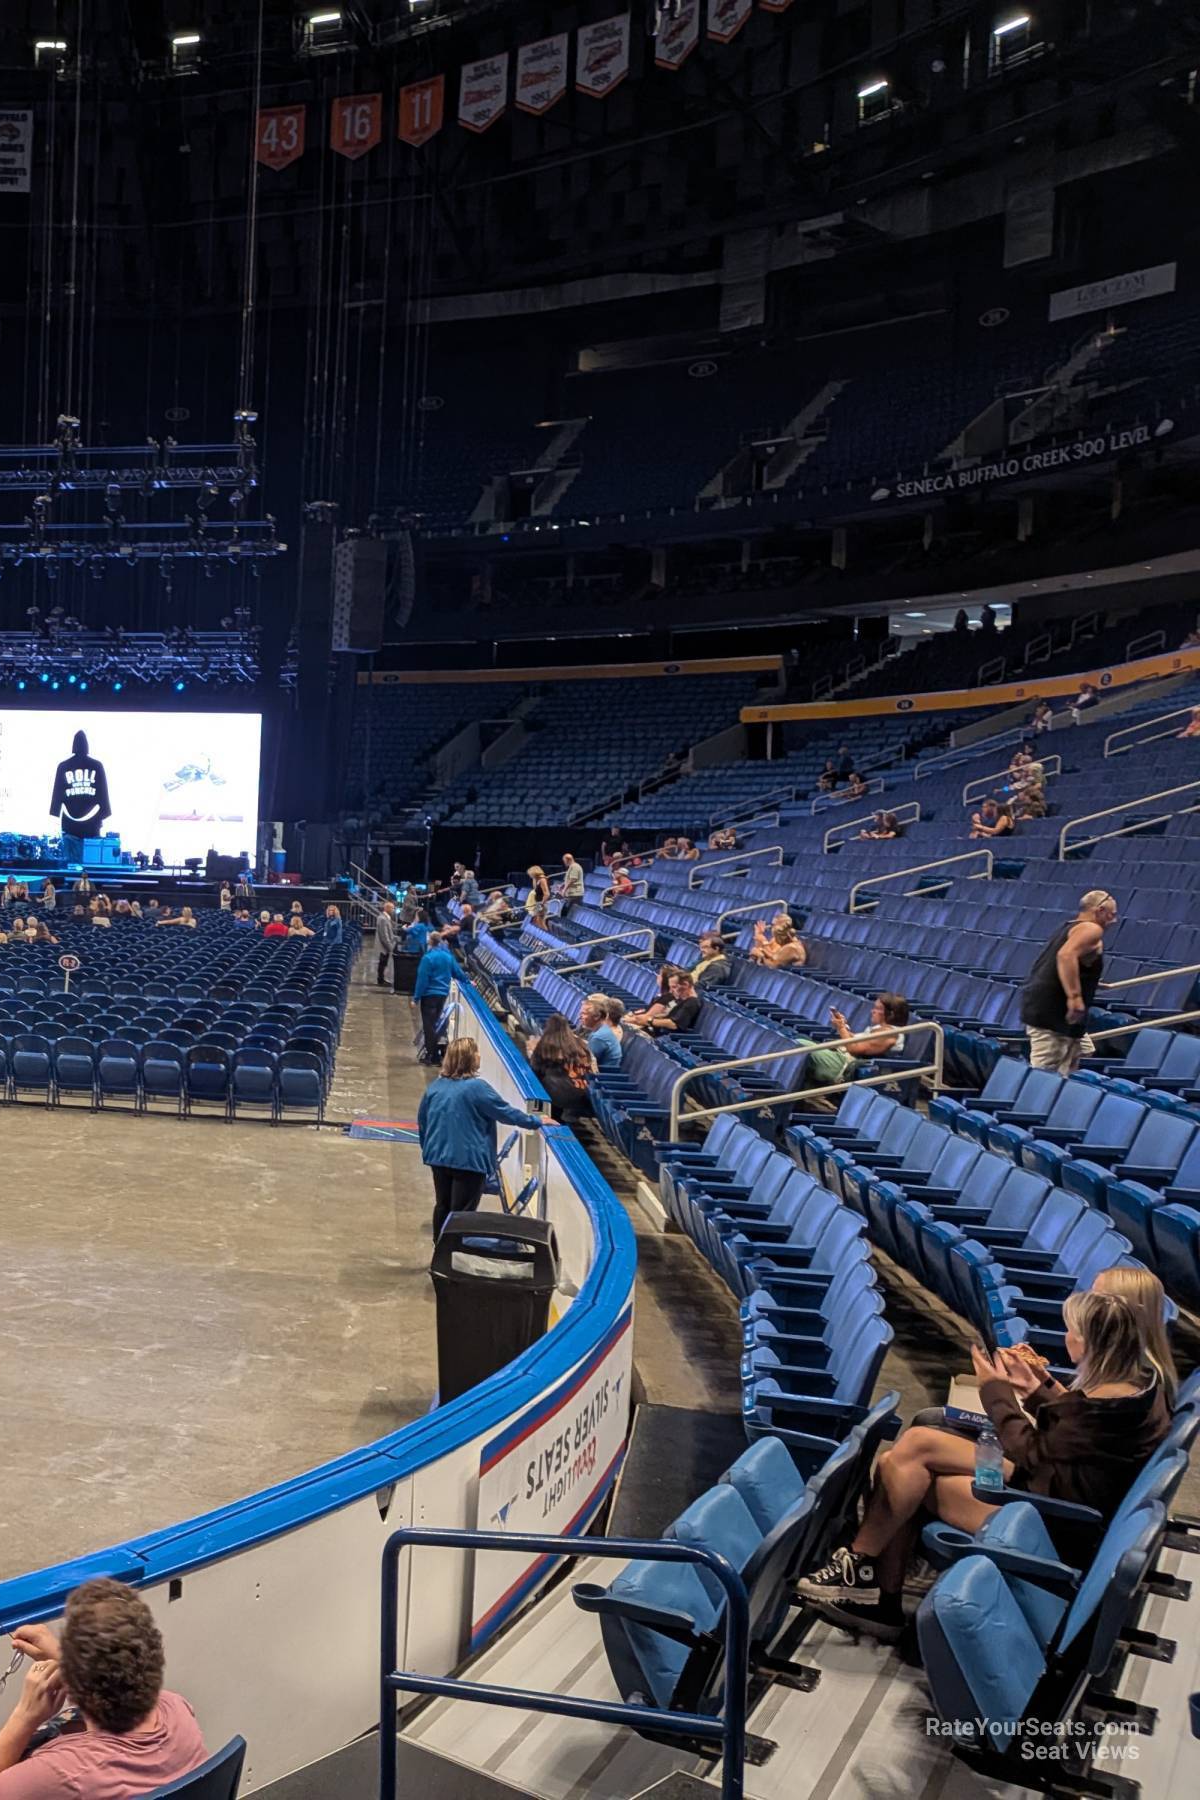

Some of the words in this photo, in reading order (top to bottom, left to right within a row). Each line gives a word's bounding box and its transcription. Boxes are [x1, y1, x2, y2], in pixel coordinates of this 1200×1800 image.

[342, 104, 372, 142] 16
[411, 88, 432, 129] 11
[262, 115, 298, 152] 43
[896, 474, 954, 498] SENECA
[958, 459, 1020, 487] BUFFALO
[1022, 447, 1071, 473] CREEK
[1073, 437, 1105, 461] 300
[1110, 424, 1152, 452] LEVEL
[65, 768, 97, 784] ROLL
[574, 1379, 610, 1450] SILVER
[526, 1427, 571, 1500] SEATS
[542, 1468, 572, 1518] LIGHT
